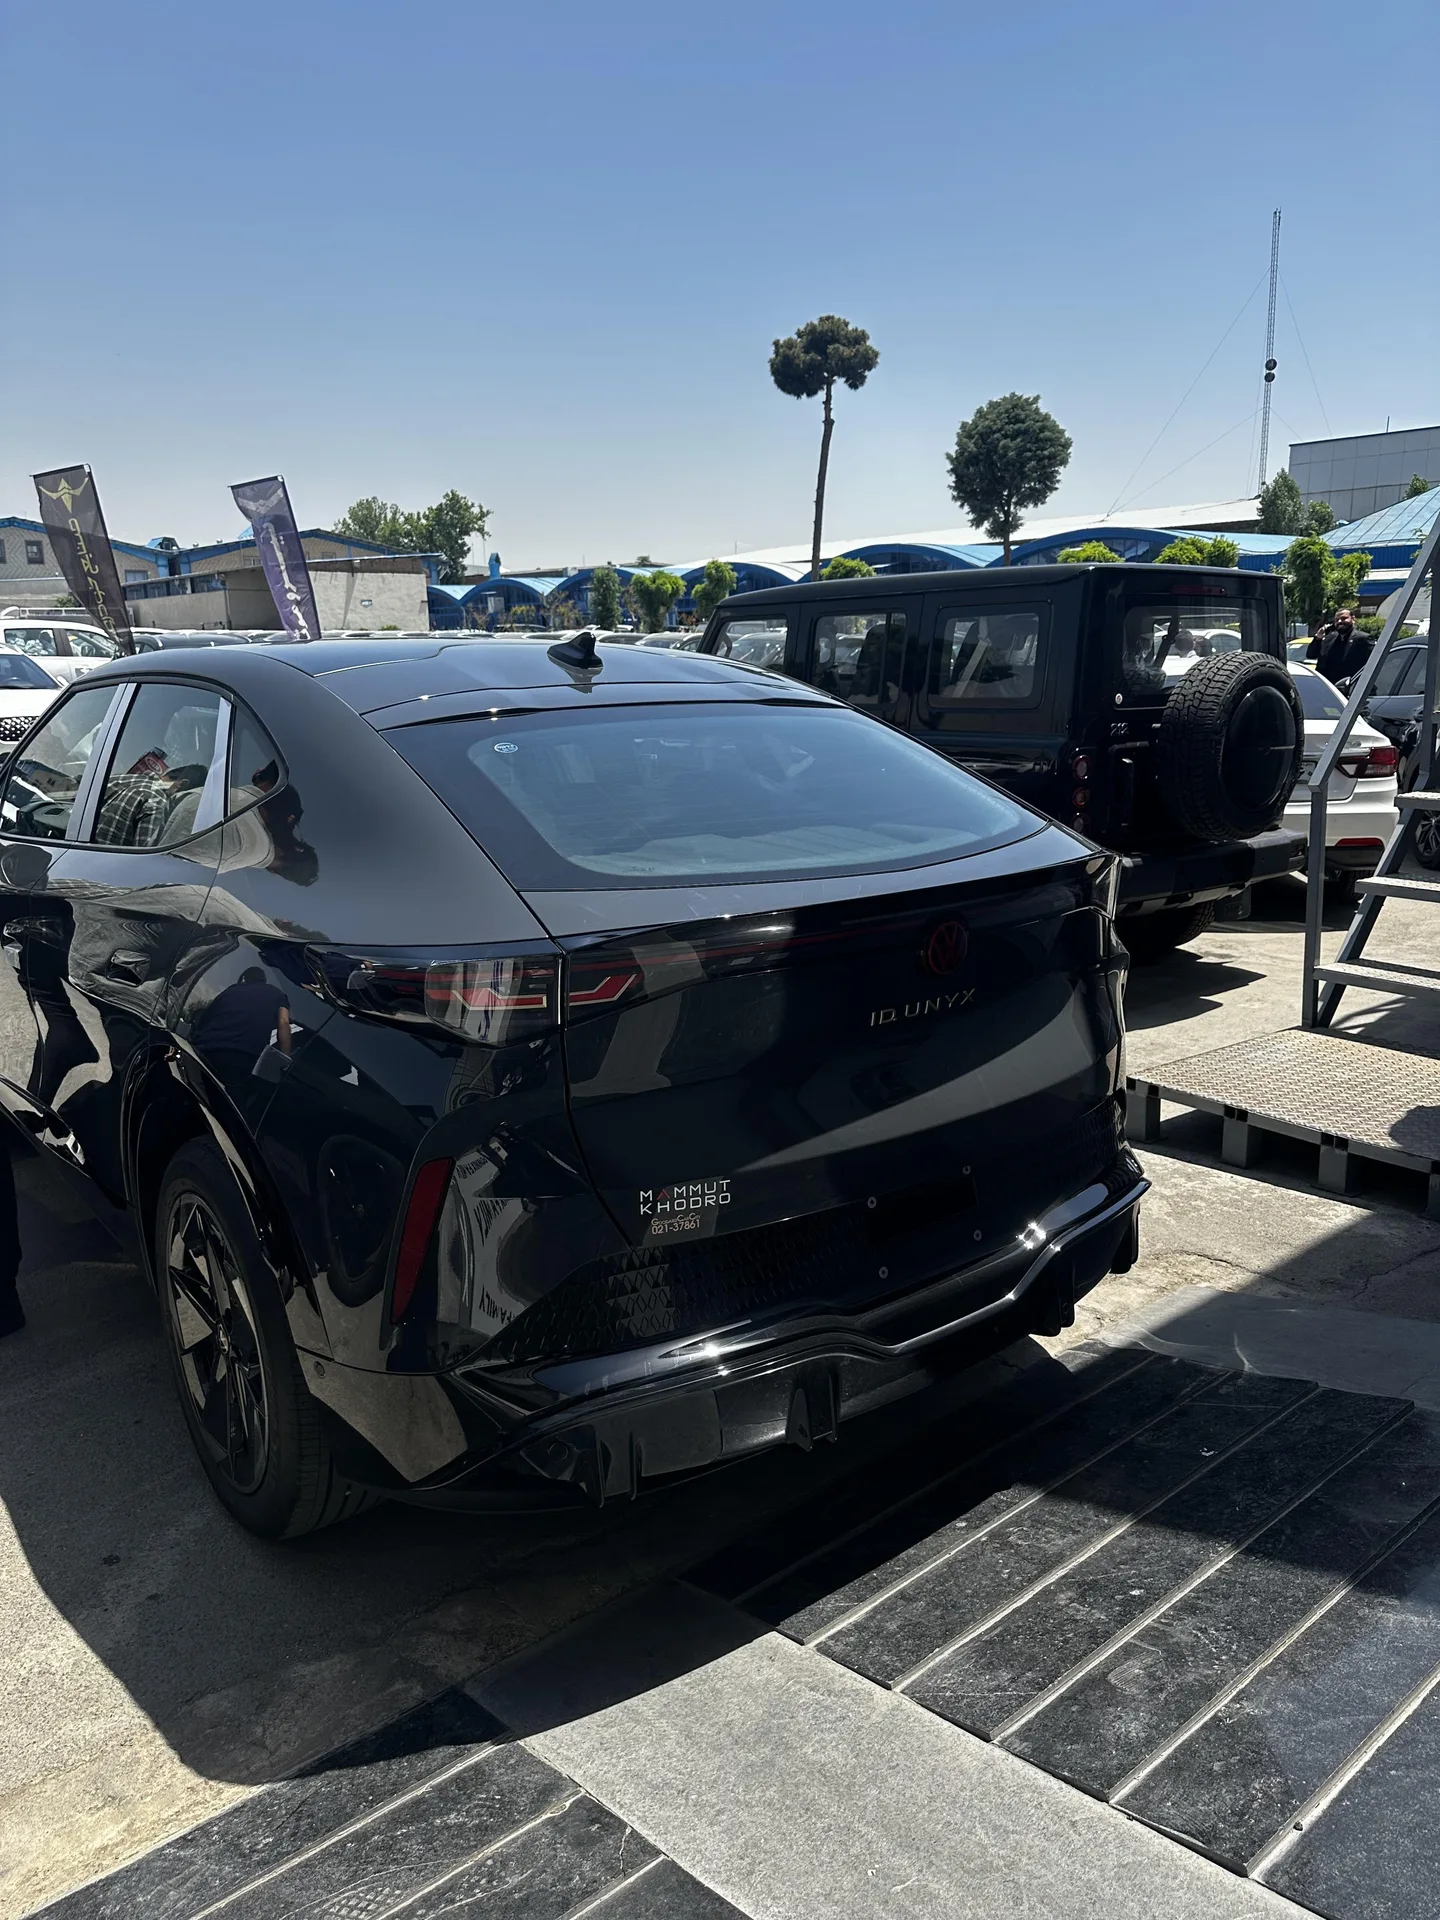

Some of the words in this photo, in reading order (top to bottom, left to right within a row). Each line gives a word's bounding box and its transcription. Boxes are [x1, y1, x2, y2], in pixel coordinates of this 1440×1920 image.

[1110, 722, 1129, 736] 212
[904, 987, 976, 1018] UNYX
[639, 1179, 731, 1203] MAMMUT
[640, 1192, 731, 1215] KHODRO
[651, 1219, 701, 1235] 021-37861
